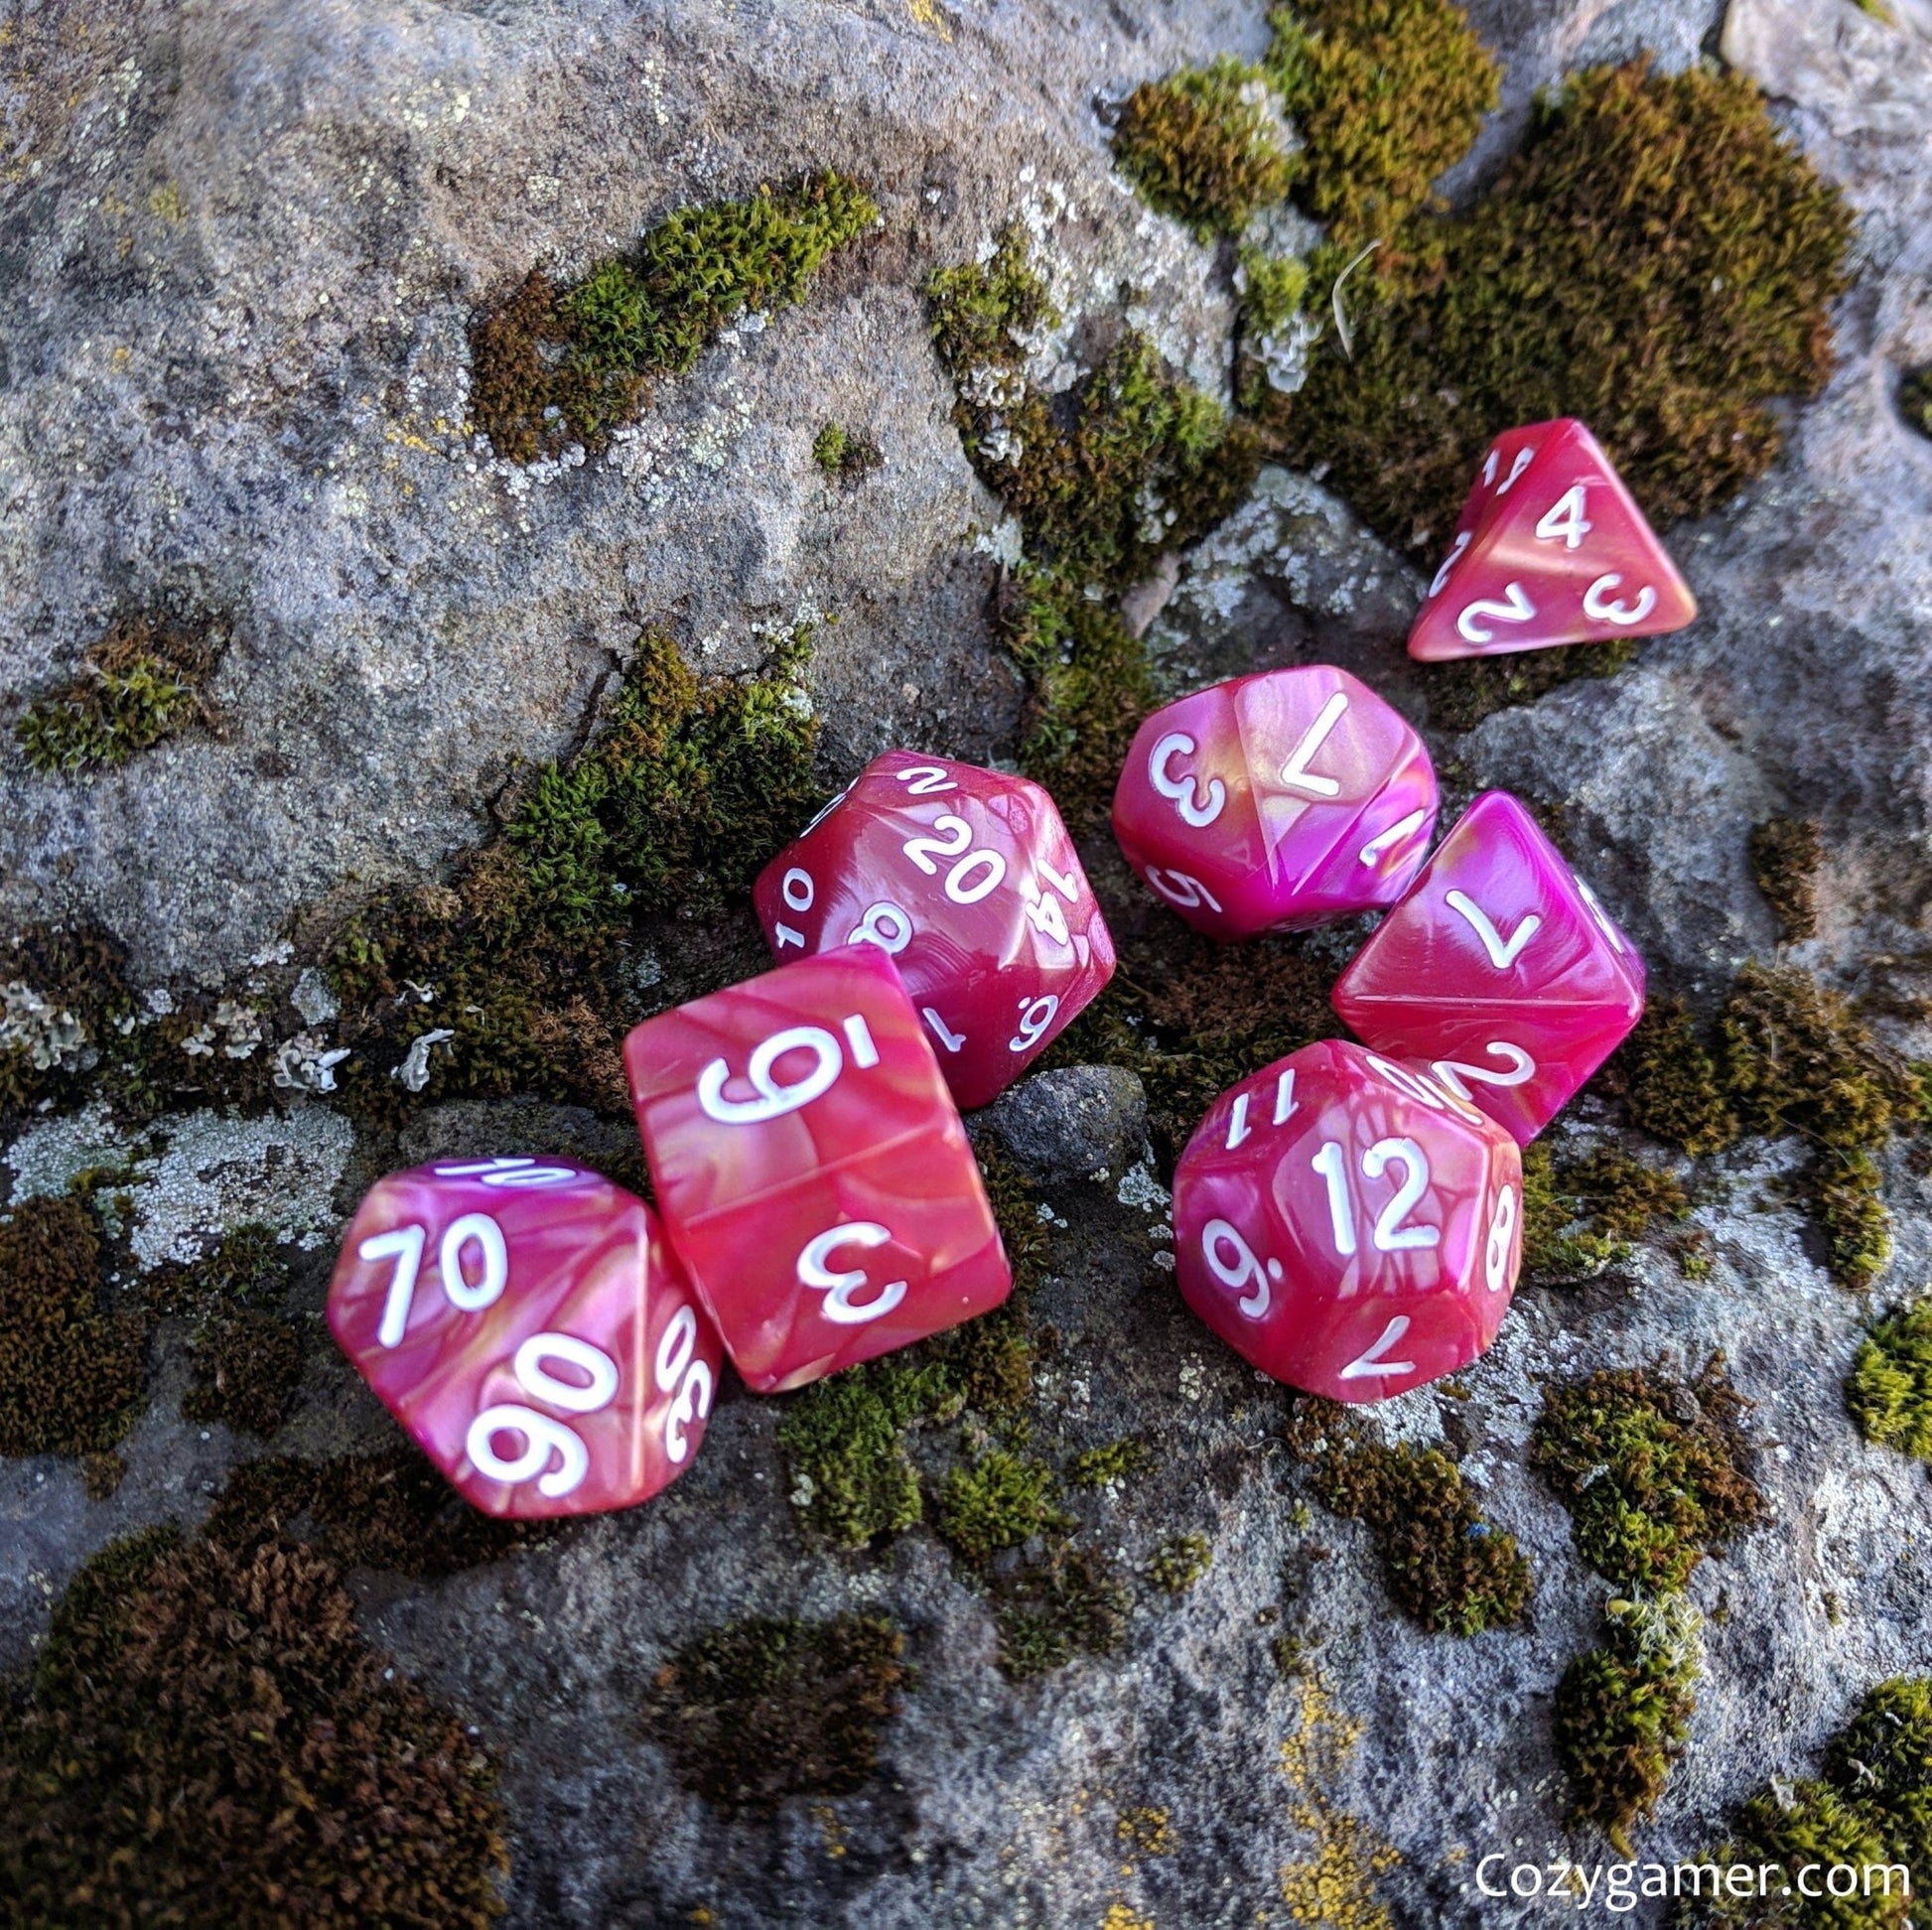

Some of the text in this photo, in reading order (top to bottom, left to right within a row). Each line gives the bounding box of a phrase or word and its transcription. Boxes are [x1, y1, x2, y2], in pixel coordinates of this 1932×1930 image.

[1536, 484, 1592, 549] 4
[1456, 581, 1537, 643] 2
[1583, 572, 1656, 624] 3
[896, 765, 959, 795] 2
[1151, 733, 1226, 827] 3
[1281, 691, 1349, 795] 7
[902, 813, 1007, 905] 20
[1146, 864, 1223, 912] 5
[774, 867, 815, 949] 10
[1025, 858, 1080, 947] 14
[1446, 889, 1540, 969] 7
[1225, 1067, 1300, 1151] 11
[1365, 1054, 1483, 1126] 10
[1431, 1041, 1537, 1102] 2
[433, 1157, 578, 1187] 10
[1311, 1137, 1440, 1256] 12
[796, 1220, 908, 1324] 3
[1484, 1183, 1515, 1292] 8
[357, 1212, 508, 1349] 70
[655, 1304, 713, 1463] 30
[1340, 1314, 1417, 1380] 7
[467, 1330, 620, 1498] 90
